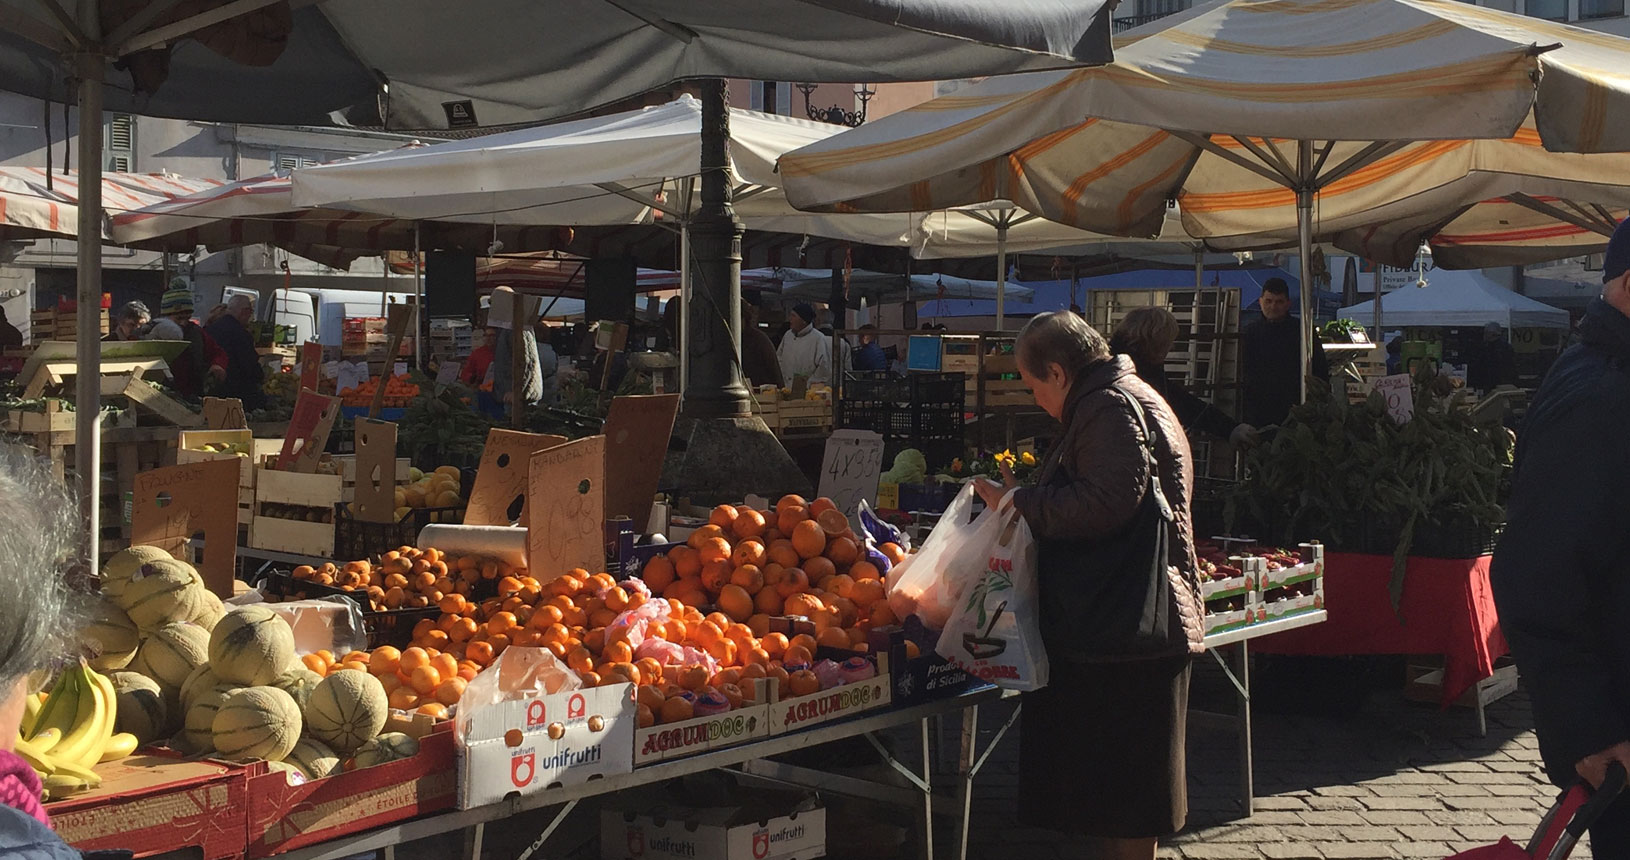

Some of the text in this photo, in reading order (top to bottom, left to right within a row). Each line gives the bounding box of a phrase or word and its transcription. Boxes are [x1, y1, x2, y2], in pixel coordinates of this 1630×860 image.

[926, 671, 966, 690] di Sicilia
[543, 743, 601, 770] unifrutti
[377, 794, 410, 809] ÉTOILE
[770, 824, 805, 844] unifrutti
[649, 836, 695, 857] unifrutti
